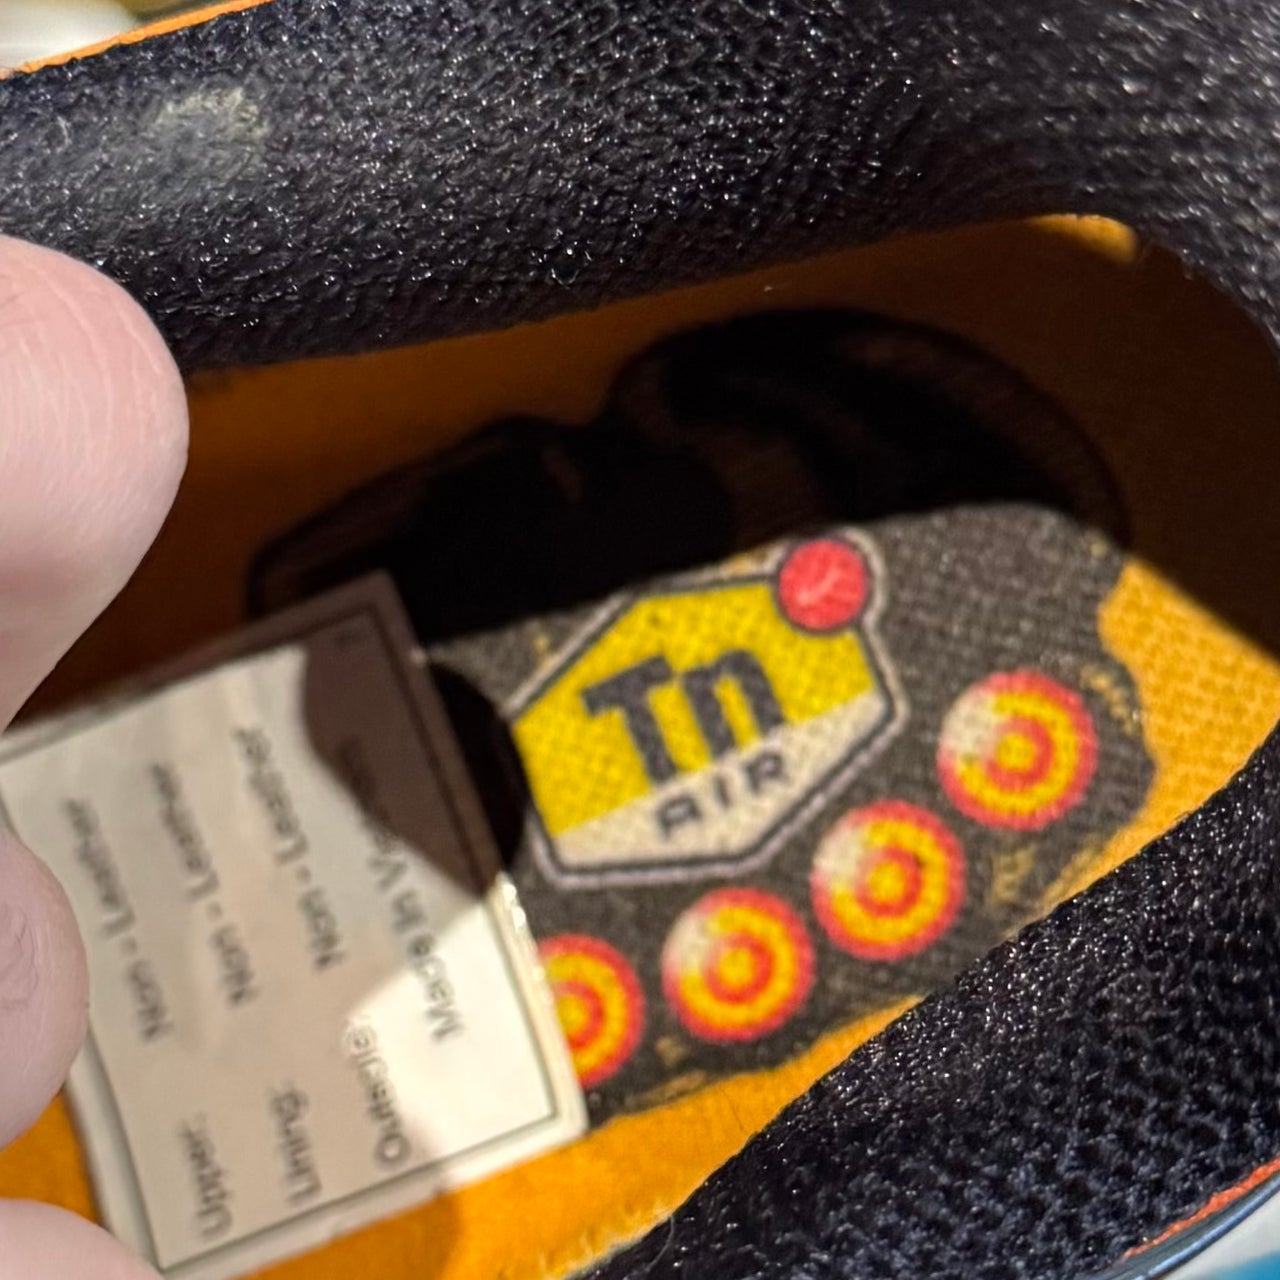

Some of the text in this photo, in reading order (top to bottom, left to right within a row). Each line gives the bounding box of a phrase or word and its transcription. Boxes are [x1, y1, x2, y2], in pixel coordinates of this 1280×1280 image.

[580, 647, 787, 786] Tn
[150, 762, 220, 900] Leather
[233, 728, 308, 866] Leather
[655, 747, 787, 840] AIR
[63, 795, 136, 938] Leather
[210, 923, 258, 1006] Non
[298, 885, 346, 972] Non
[125, 958, 172, 1042] Non
[407, 932, 463, 1042] Made
